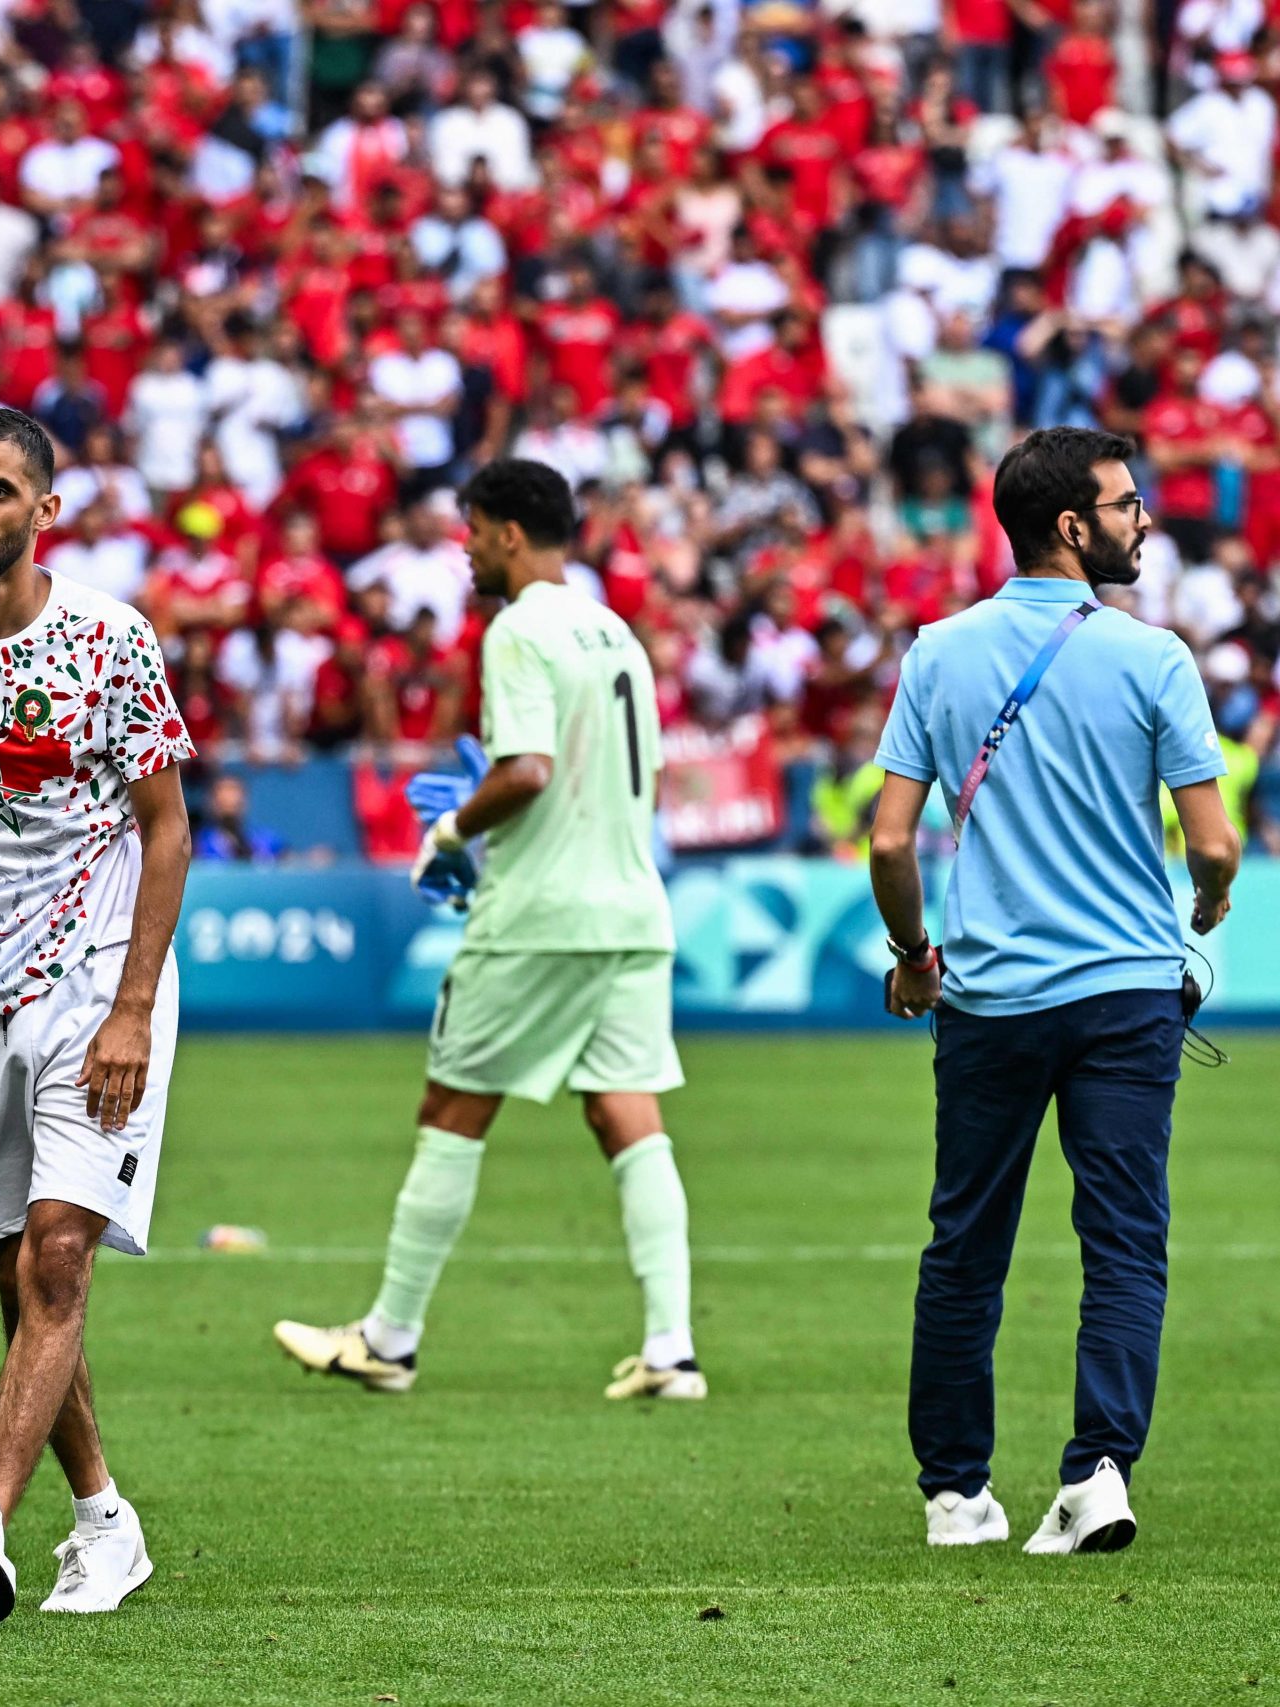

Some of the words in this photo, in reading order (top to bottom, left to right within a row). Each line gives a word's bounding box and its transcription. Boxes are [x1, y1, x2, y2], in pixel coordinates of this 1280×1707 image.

[614, 671, 641, 798] 1
[1004, 700, 1018, 720] Atos
[188, 907, 356, 964] 2024
